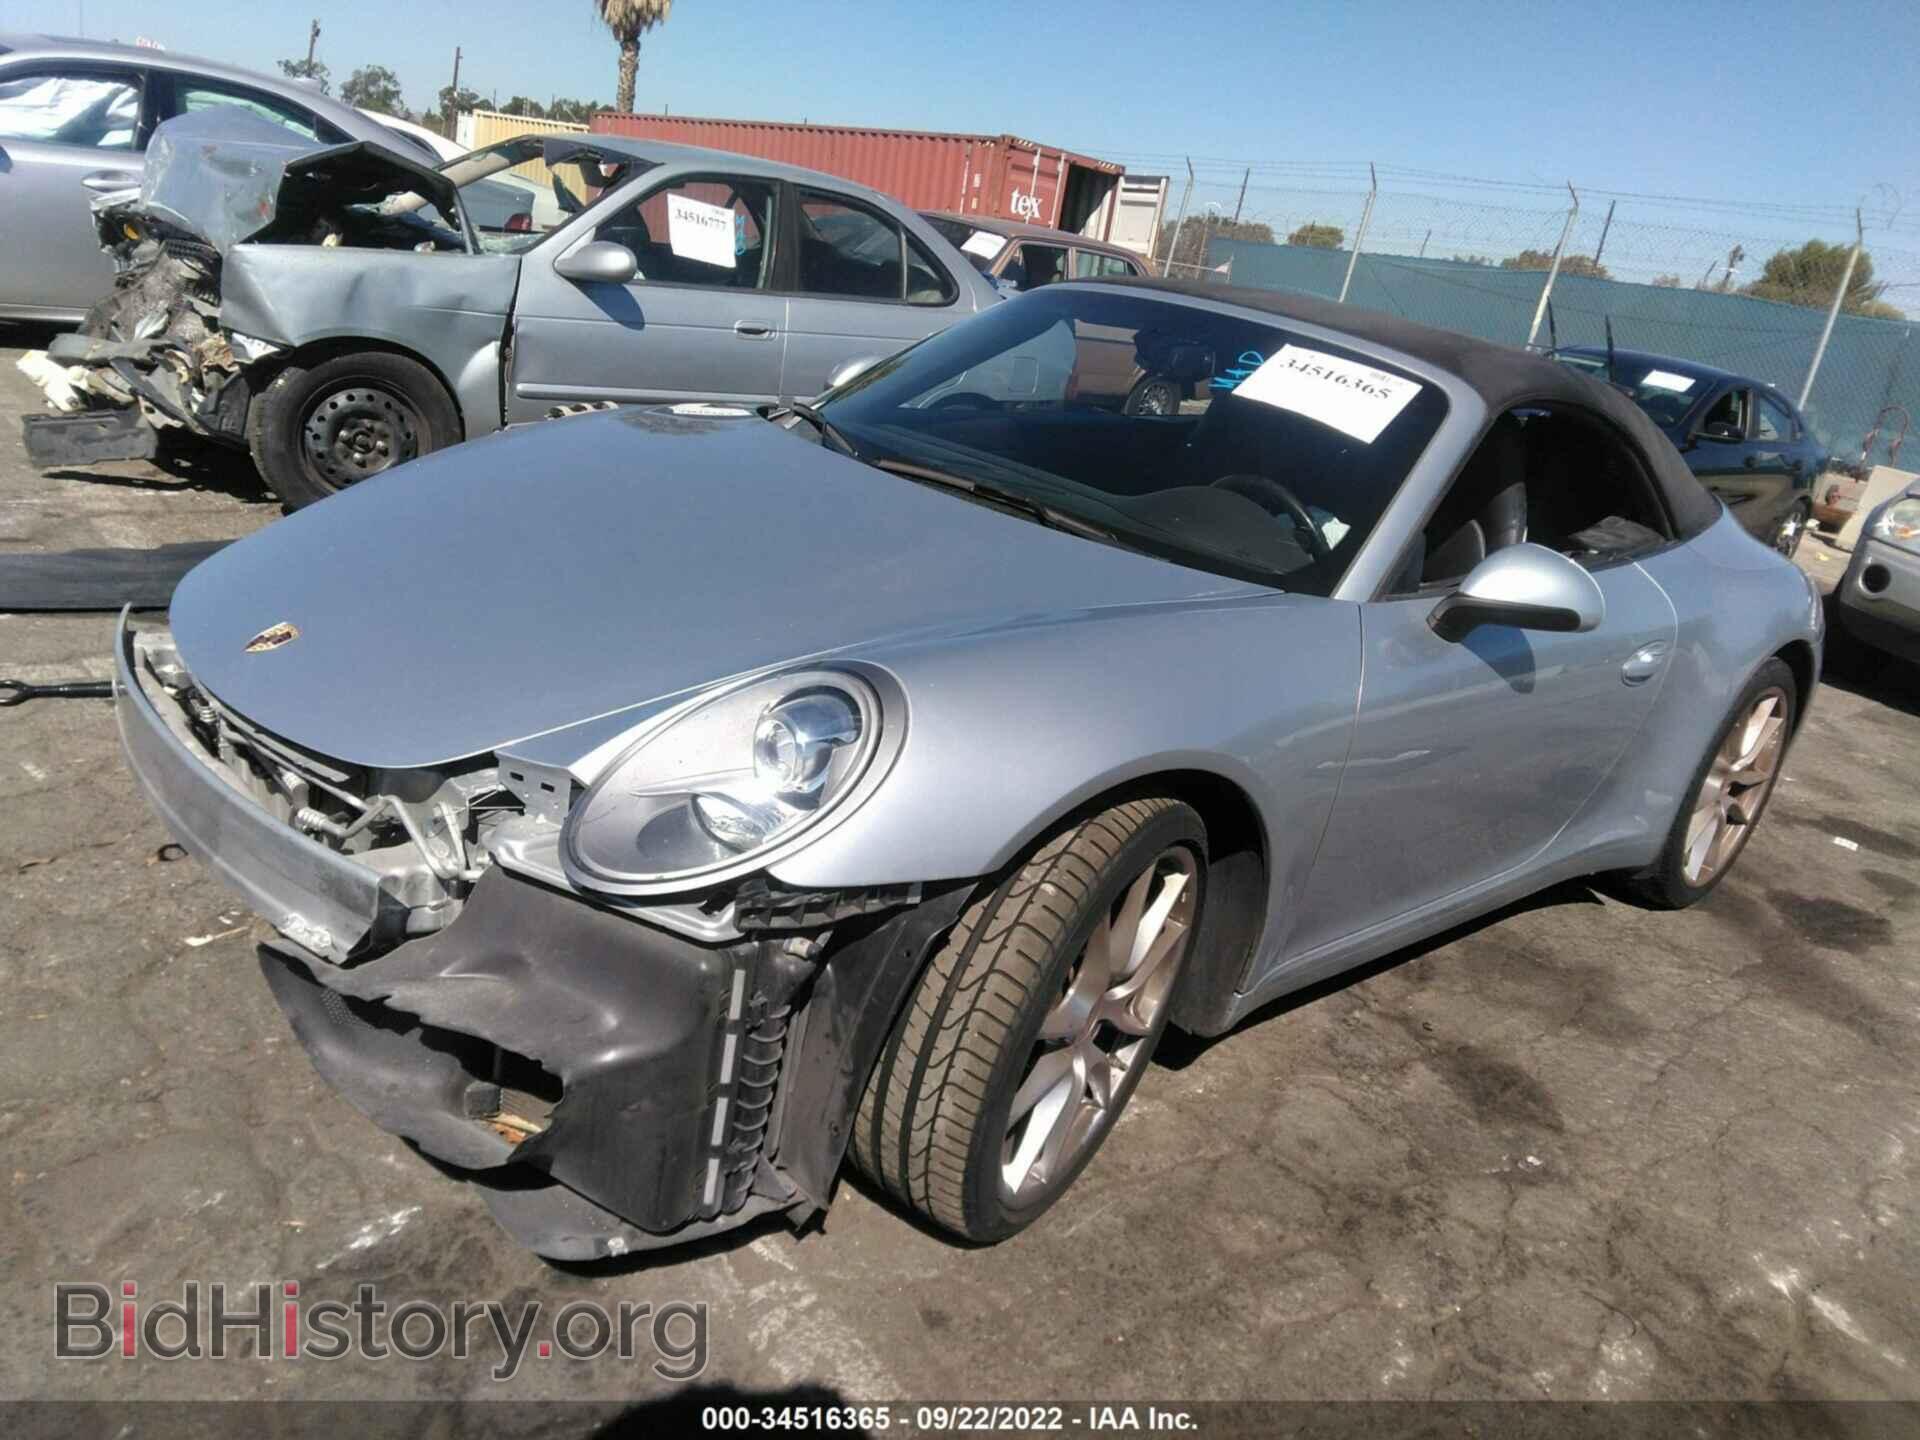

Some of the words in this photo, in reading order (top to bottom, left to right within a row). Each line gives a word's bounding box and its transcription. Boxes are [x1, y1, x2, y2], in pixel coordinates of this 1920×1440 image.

[1010, 186, 1043, 219] tex
[674, 208, 727, 231] 34516777
[1279, 357, 1393, 400] 34516365
